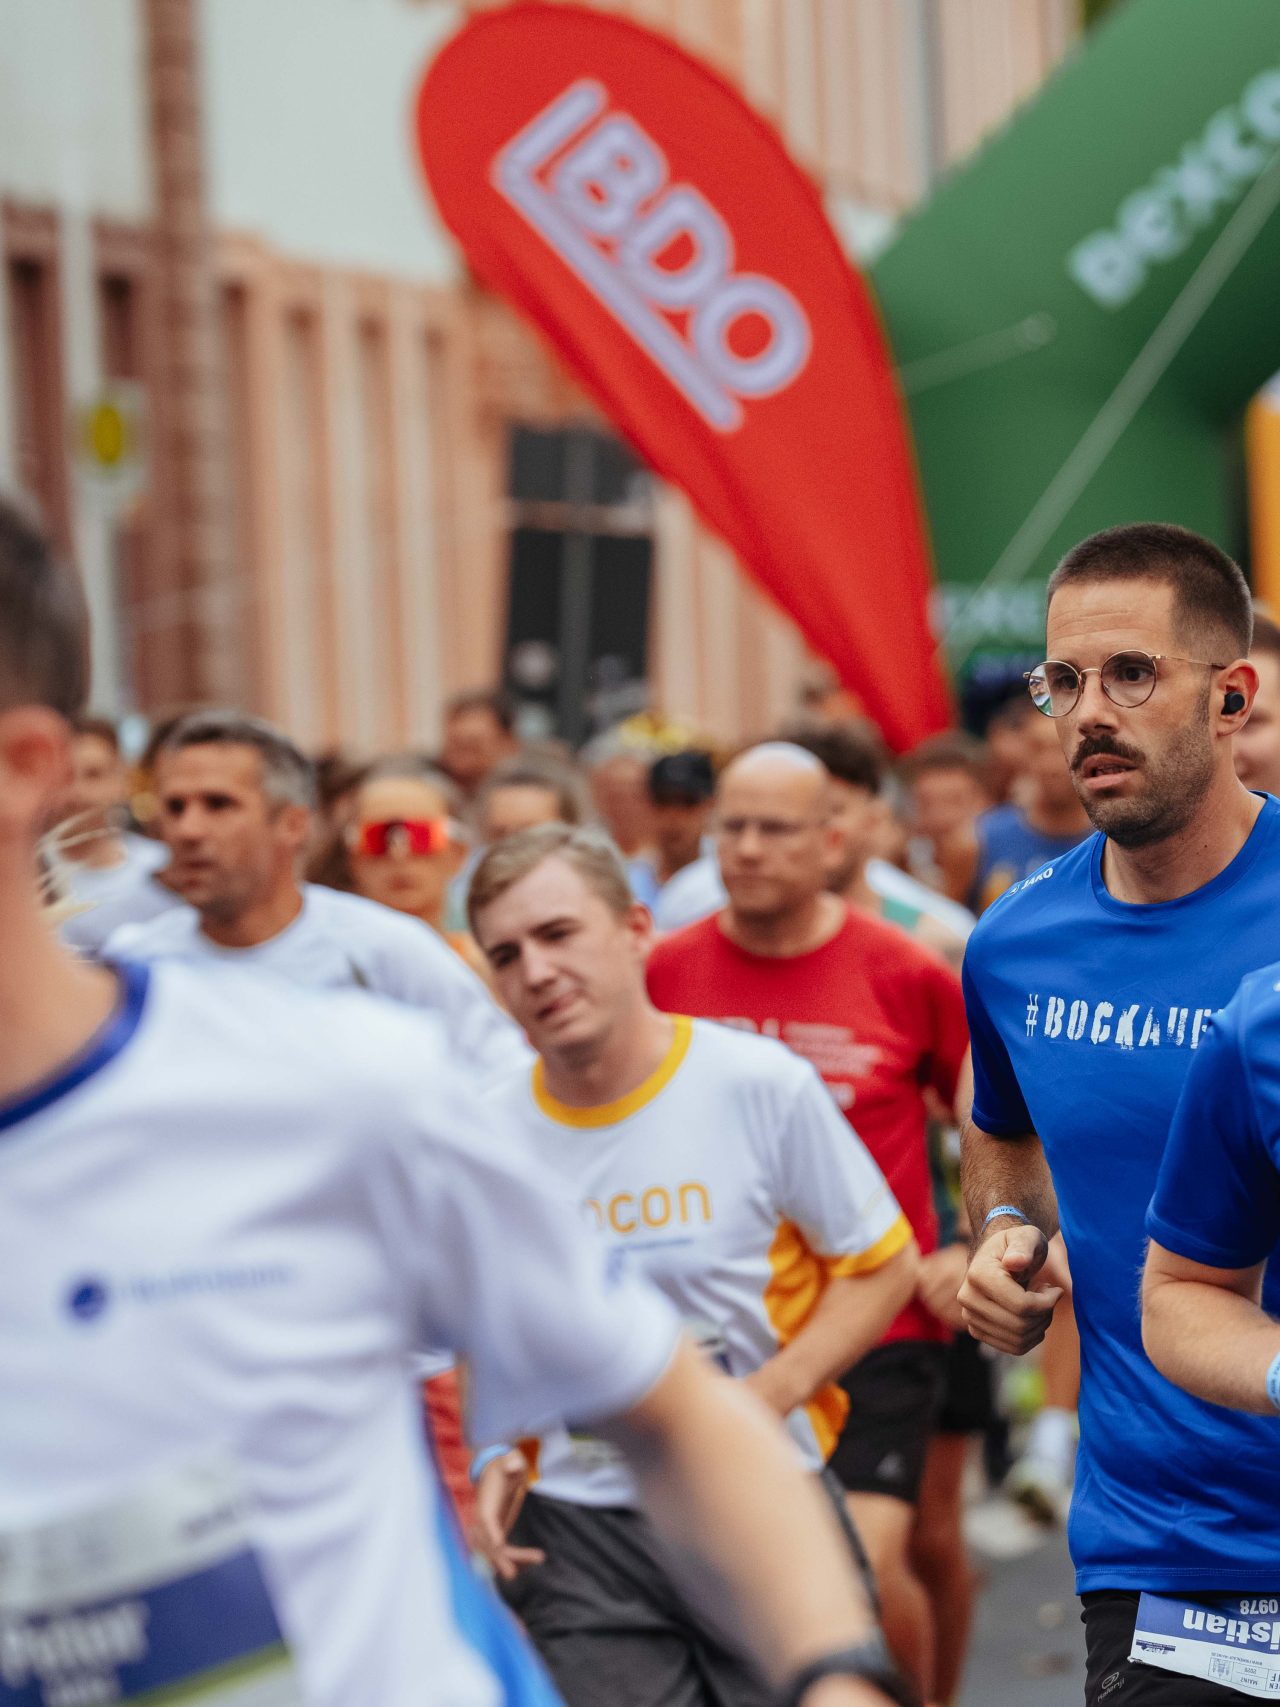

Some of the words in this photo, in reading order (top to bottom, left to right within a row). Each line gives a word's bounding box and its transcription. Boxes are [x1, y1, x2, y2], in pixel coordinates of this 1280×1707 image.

[550, 110, 812, 402] BDO
[1026, 993, 1225, 1050] #BOCKAUF
[588, 1182, 712, 1235] con
